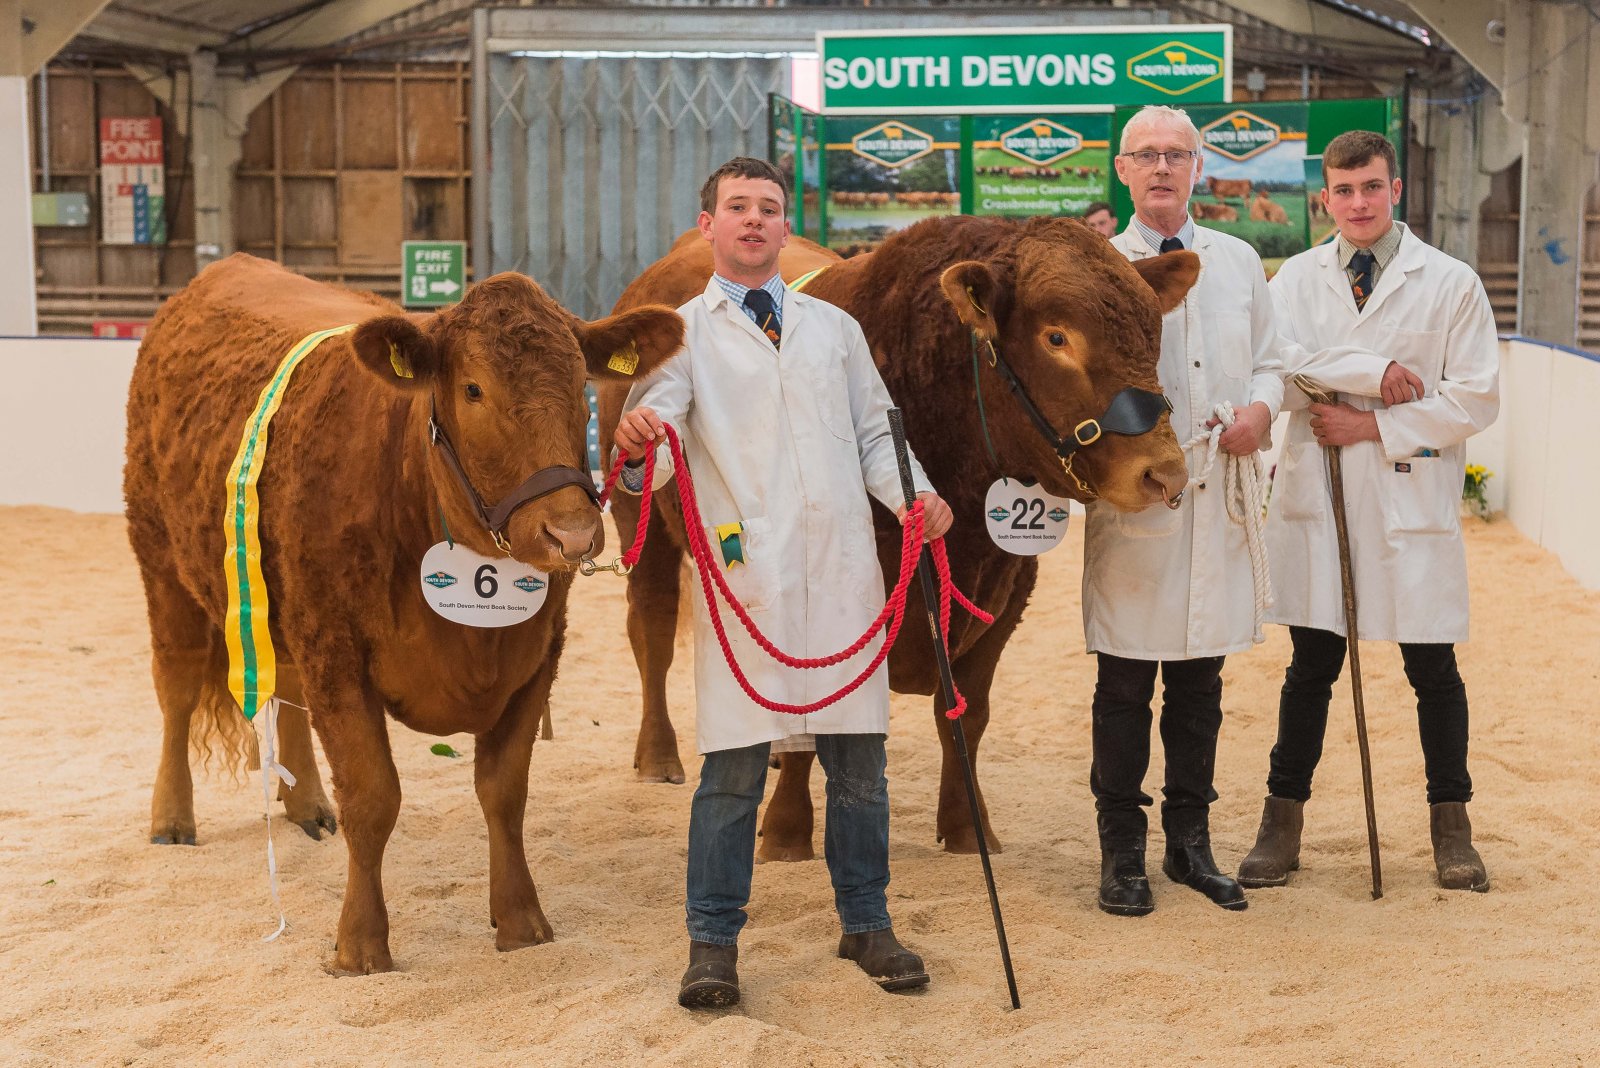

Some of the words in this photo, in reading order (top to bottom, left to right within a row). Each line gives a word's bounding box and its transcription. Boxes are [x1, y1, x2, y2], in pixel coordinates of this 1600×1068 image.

[824, 57, 950, 89] SOUTH
[961, 54, 1116, 86] DEVONS
[1134, 65, 1171, 76] SOUTH
[1172, 64, 1217, 76] DEVONS
[110, 119, 151, 139] FIRE
[1205, 131, 1236, 142] SOUTH
[1237, 130, 1275, 142] DEVONS
[858, 139, 888, 151] SOUTH
[890, 139, 929, 151] DEVONS
[1006, 138, 1037, 149] SOUTH
[1038, 138, 1077, 149] DEVONS
[101, 140, 161, 160] POINT
[980, 184, 1000, 195] The
[1002, 183, 1038, 195] Native
[1039, 183, 1104, 195] Commercial
[982, 199, 1061, 213] Crossbreeding
[415, 250, 452, 261] FIRE
[416, 262, 450, 274] EXIT
[1011, 498, 1046, 529] 22
[474, 564, 499, 599] 6
[507, 604, 528, 612] Society
